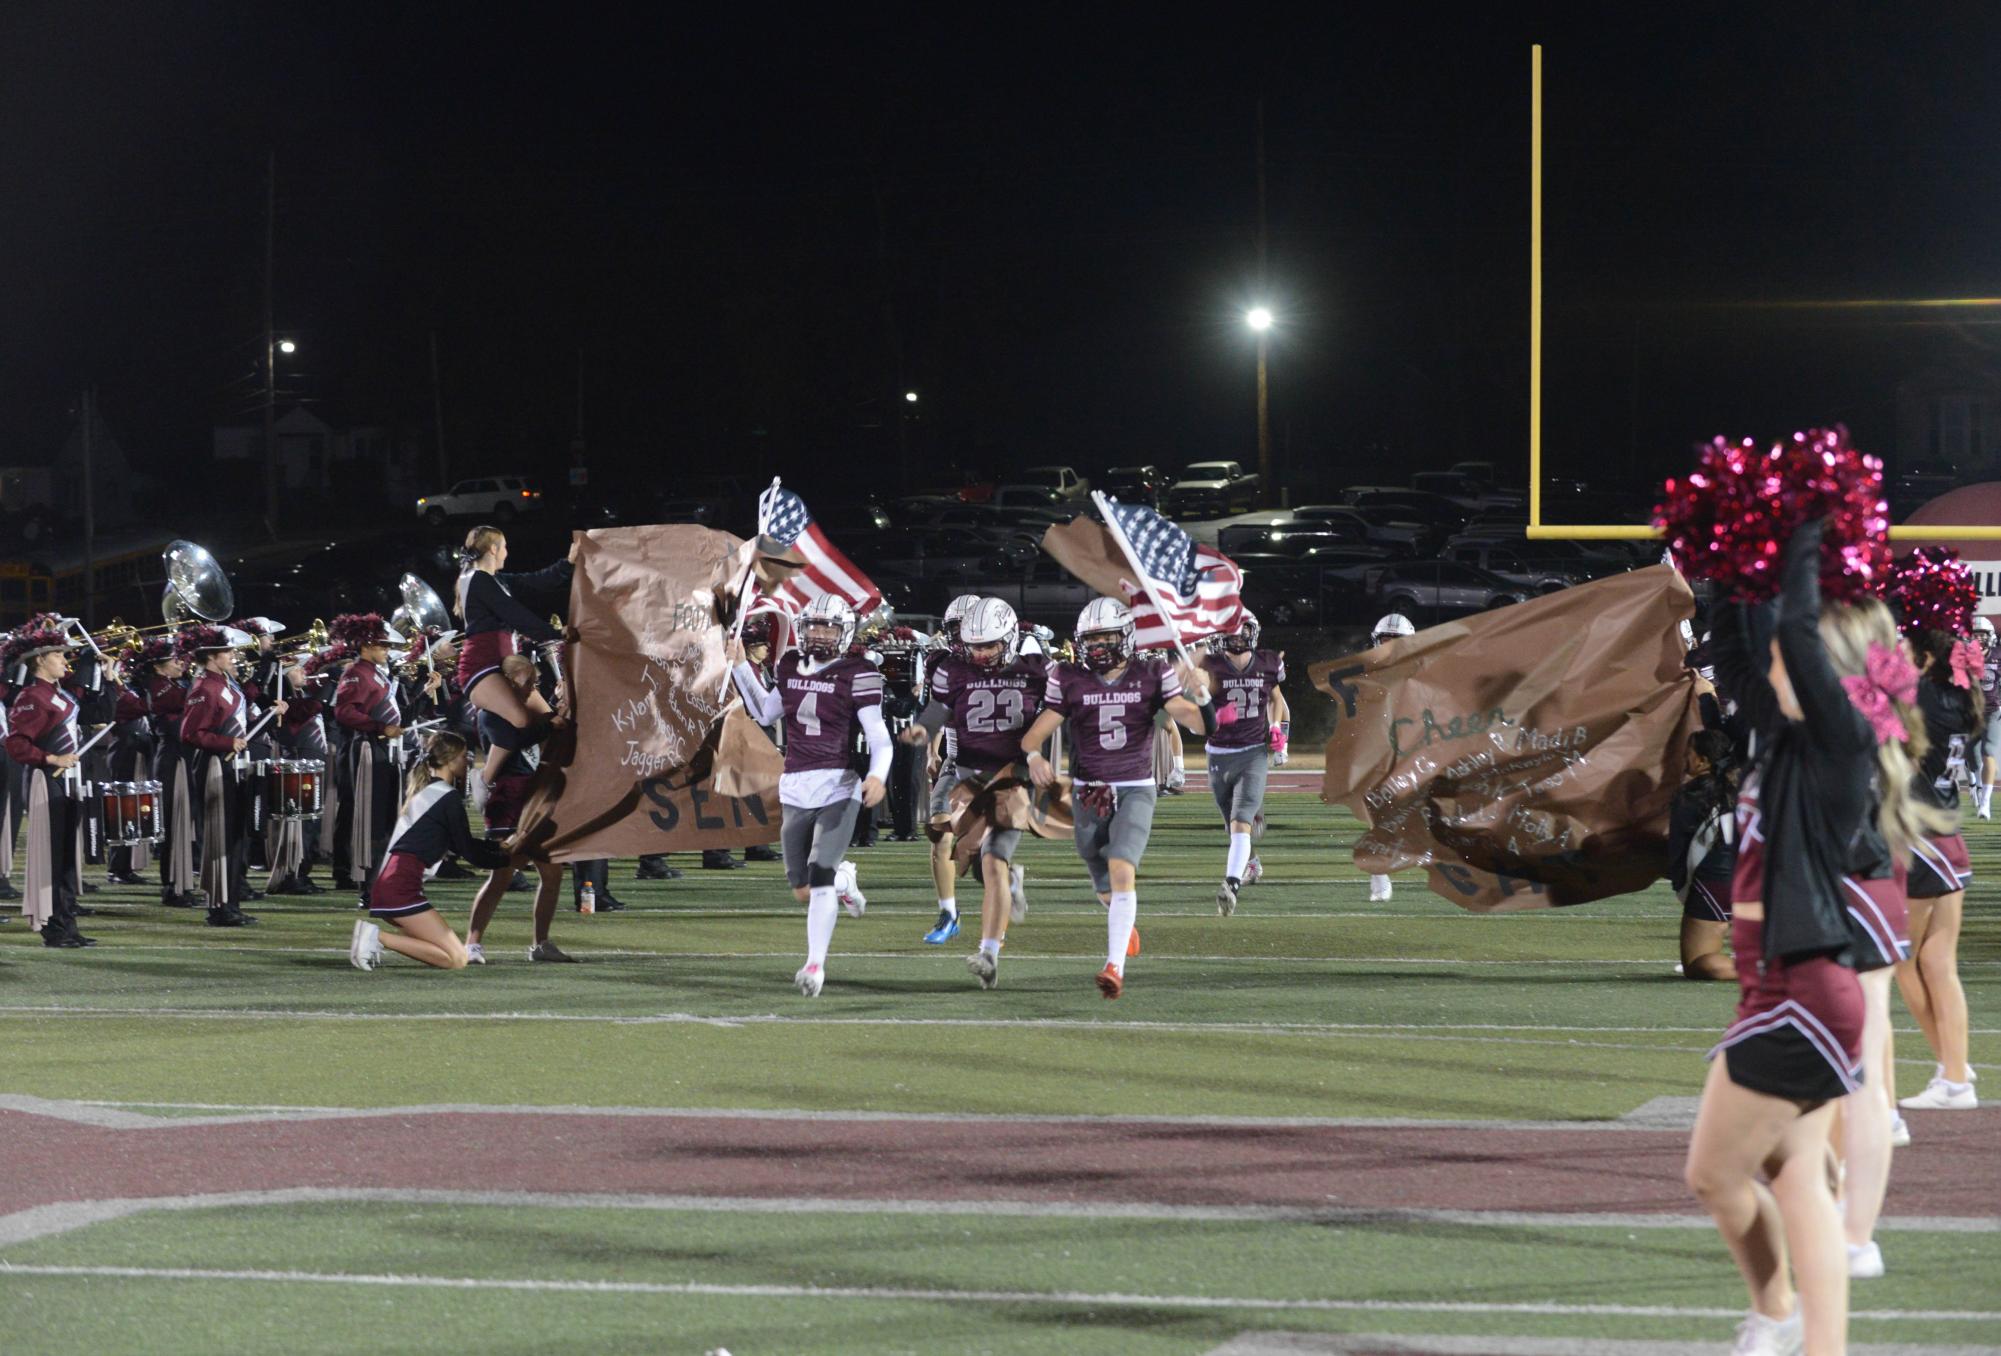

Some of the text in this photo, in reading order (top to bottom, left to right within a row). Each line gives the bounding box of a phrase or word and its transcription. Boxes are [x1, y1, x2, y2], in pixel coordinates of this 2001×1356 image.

[787, 678, 836, 694] BULLDOGS
[1082, 692, 1142, 705] BULLDOGS
[1222, 679, 1264, 689] BULLDOGS
[796, 691, 821, 736] 4
[966, 688, 1024, 733] 23
[1226, 687, 1260, 719] 21
[1098, 704, 1128, 751] 5
[621, 740, 666, 777] Jagger
